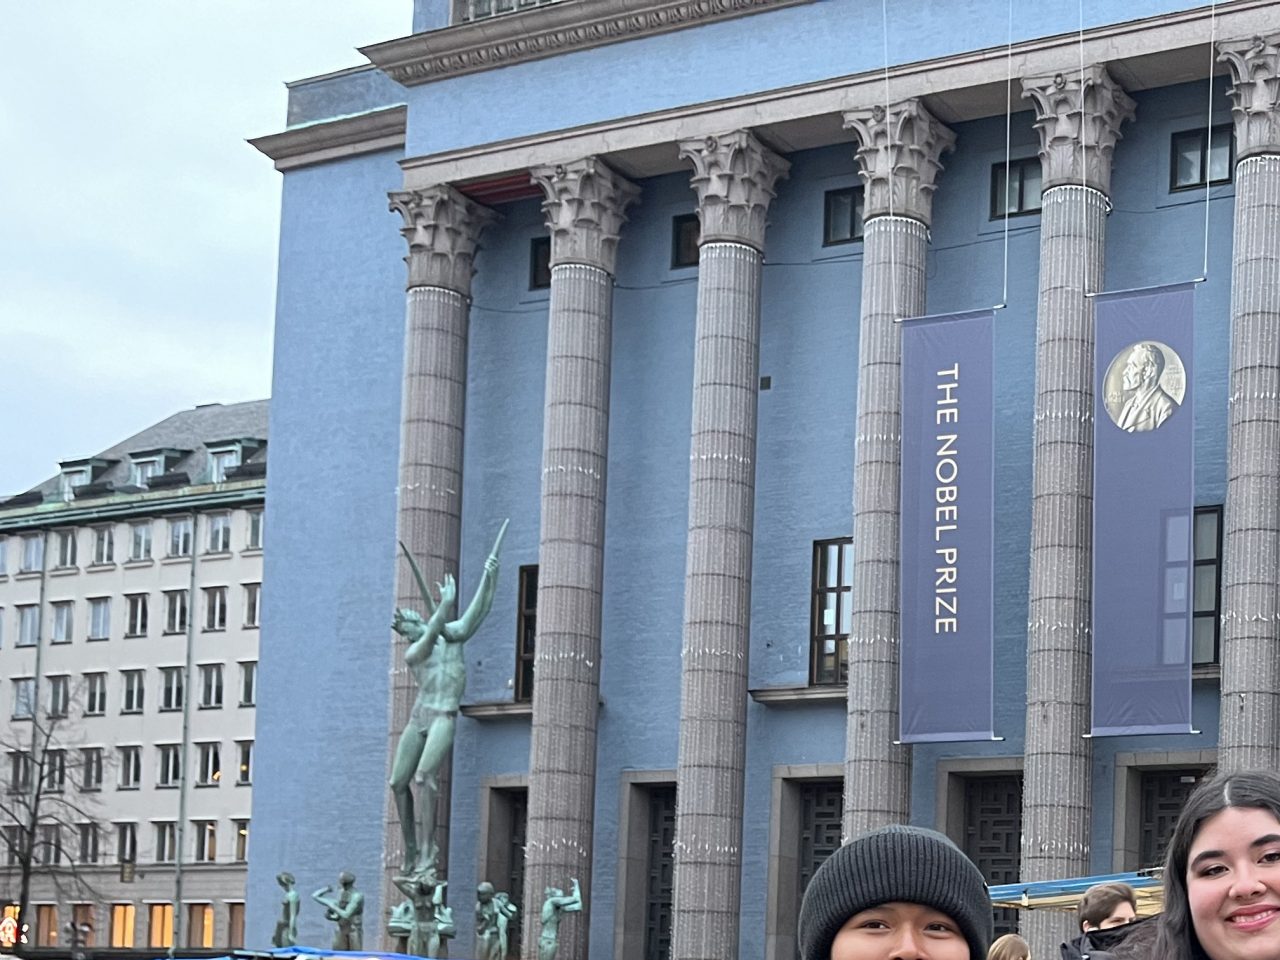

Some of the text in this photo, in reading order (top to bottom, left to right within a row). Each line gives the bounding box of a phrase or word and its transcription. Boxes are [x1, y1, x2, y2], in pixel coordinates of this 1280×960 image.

[935, 362, 959, 634] THE NOBEL PRIZE
